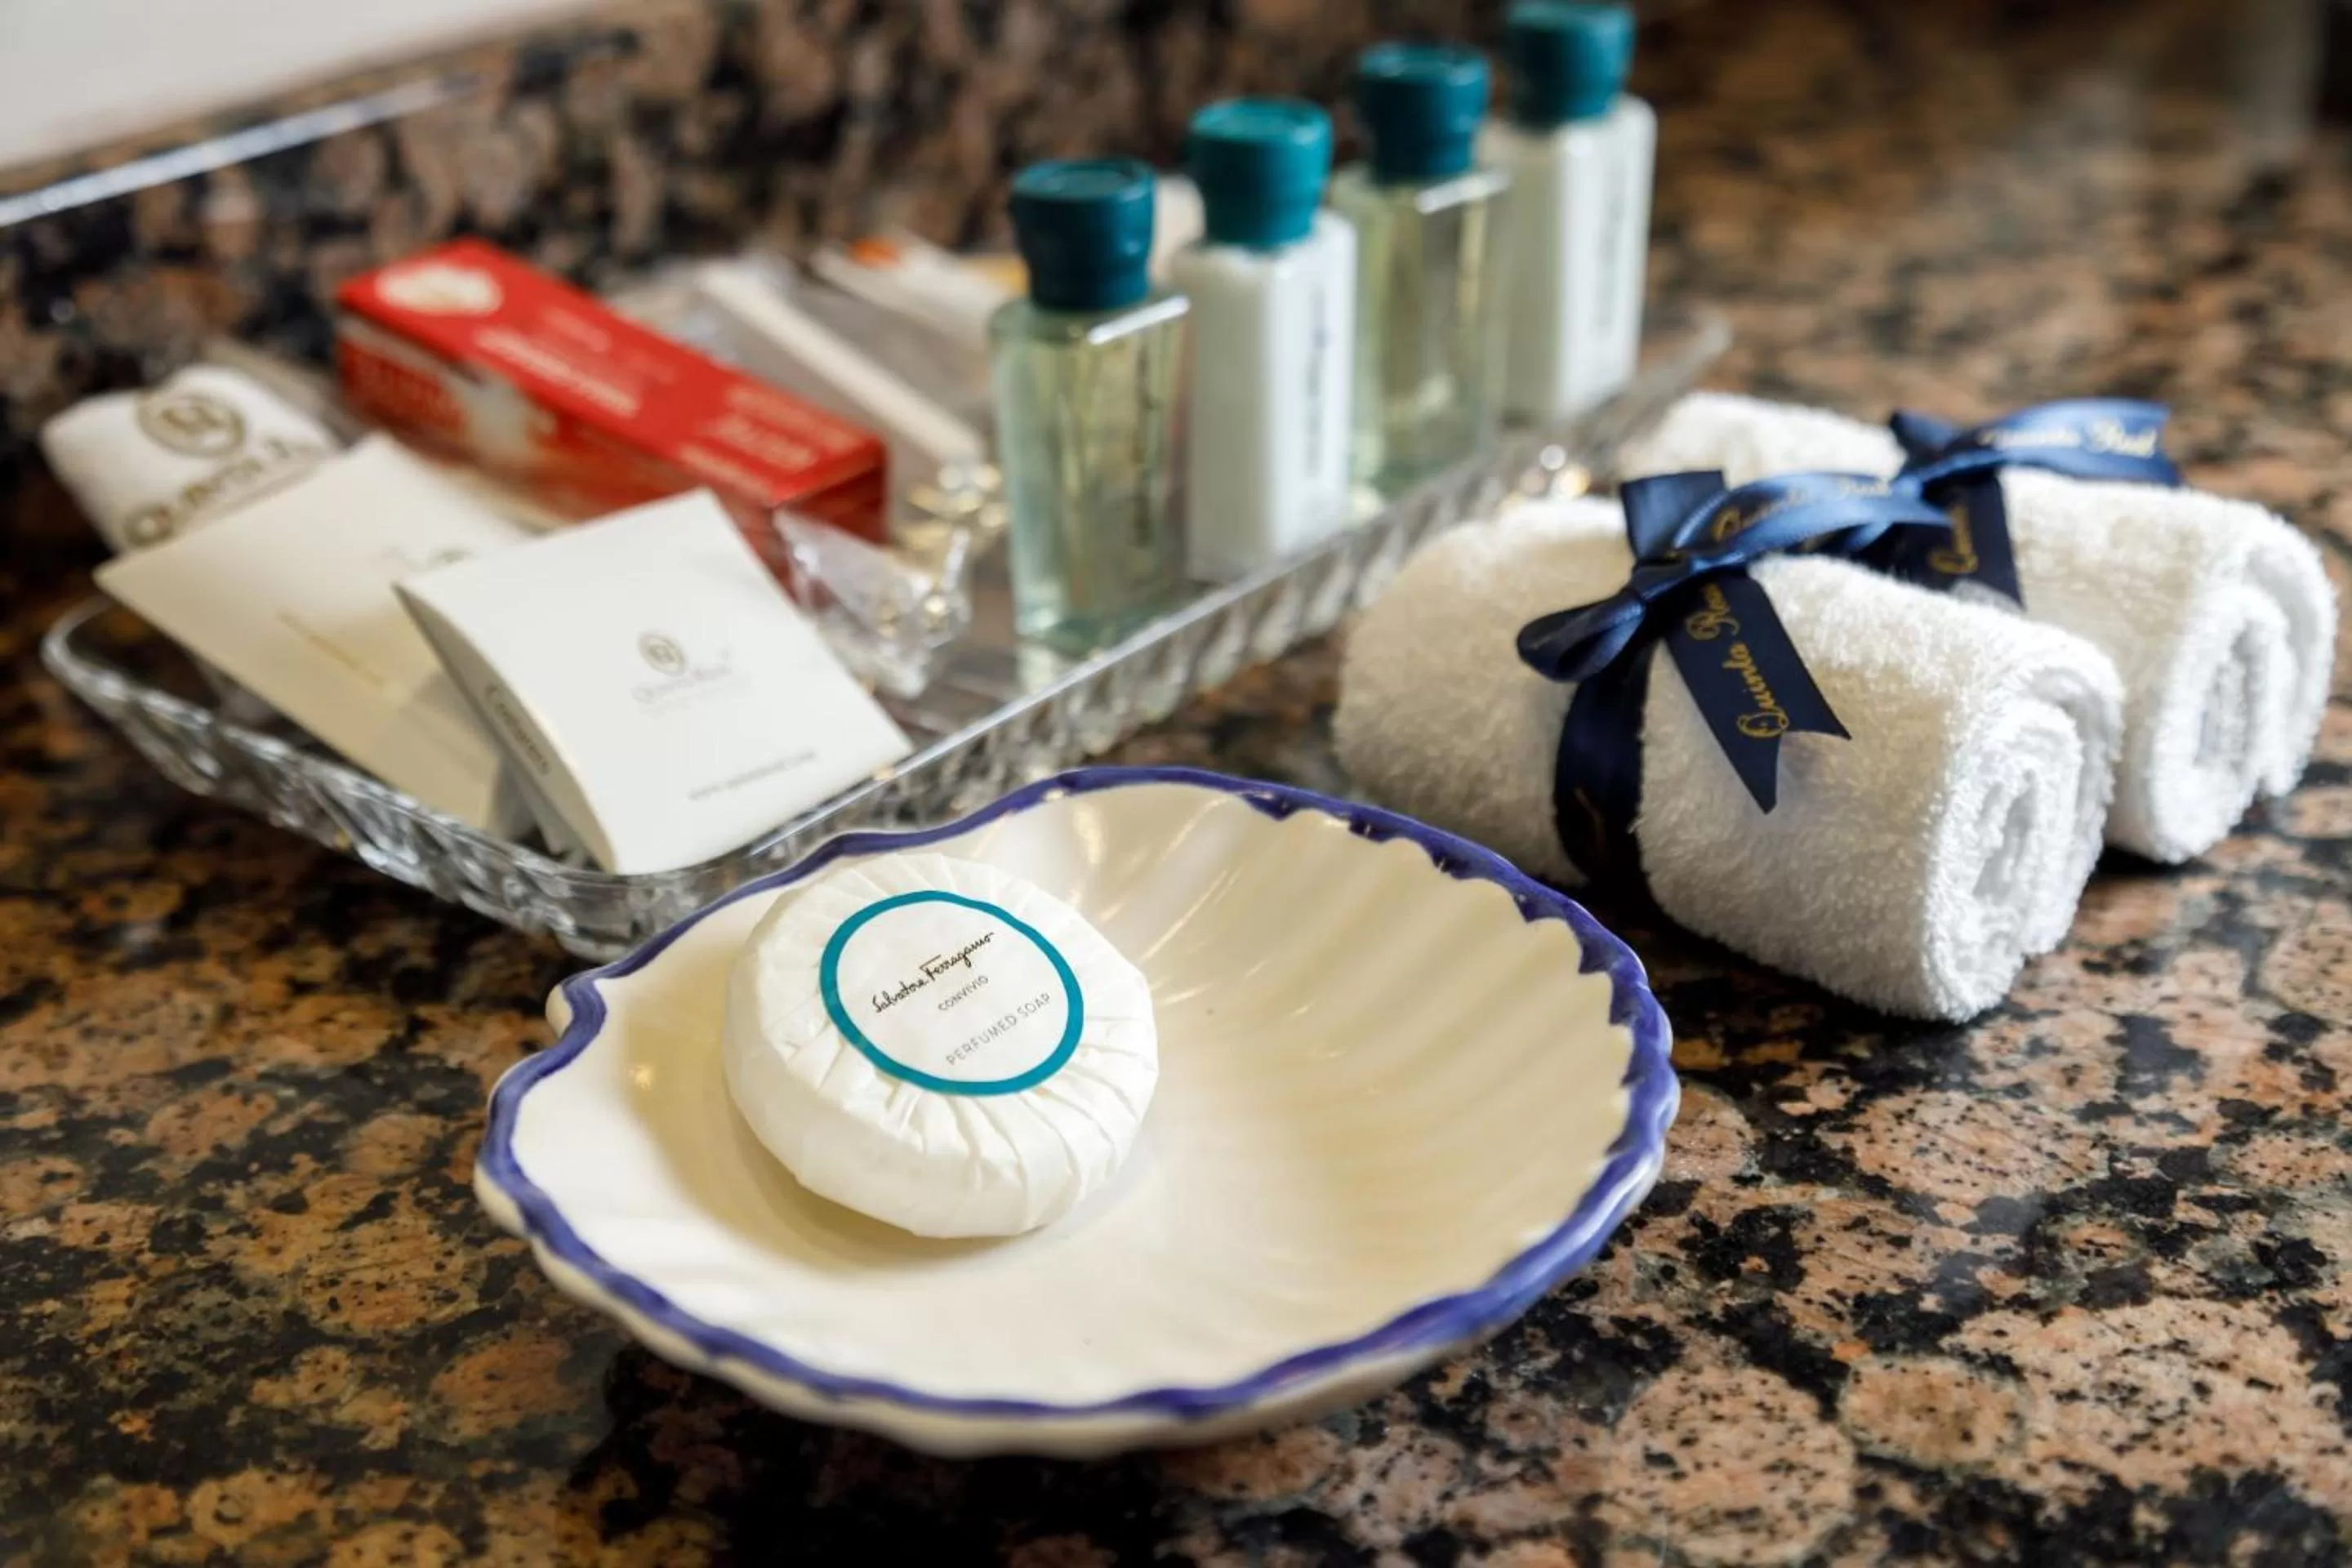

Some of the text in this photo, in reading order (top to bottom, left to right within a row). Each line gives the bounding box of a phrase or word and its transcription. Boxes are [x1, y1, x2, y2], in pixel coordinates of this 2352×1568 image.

[872, 932, 996, 1013] Salvatore Ferragamo
[946, 992, 1050, 1066] PERFUMED SOAP
